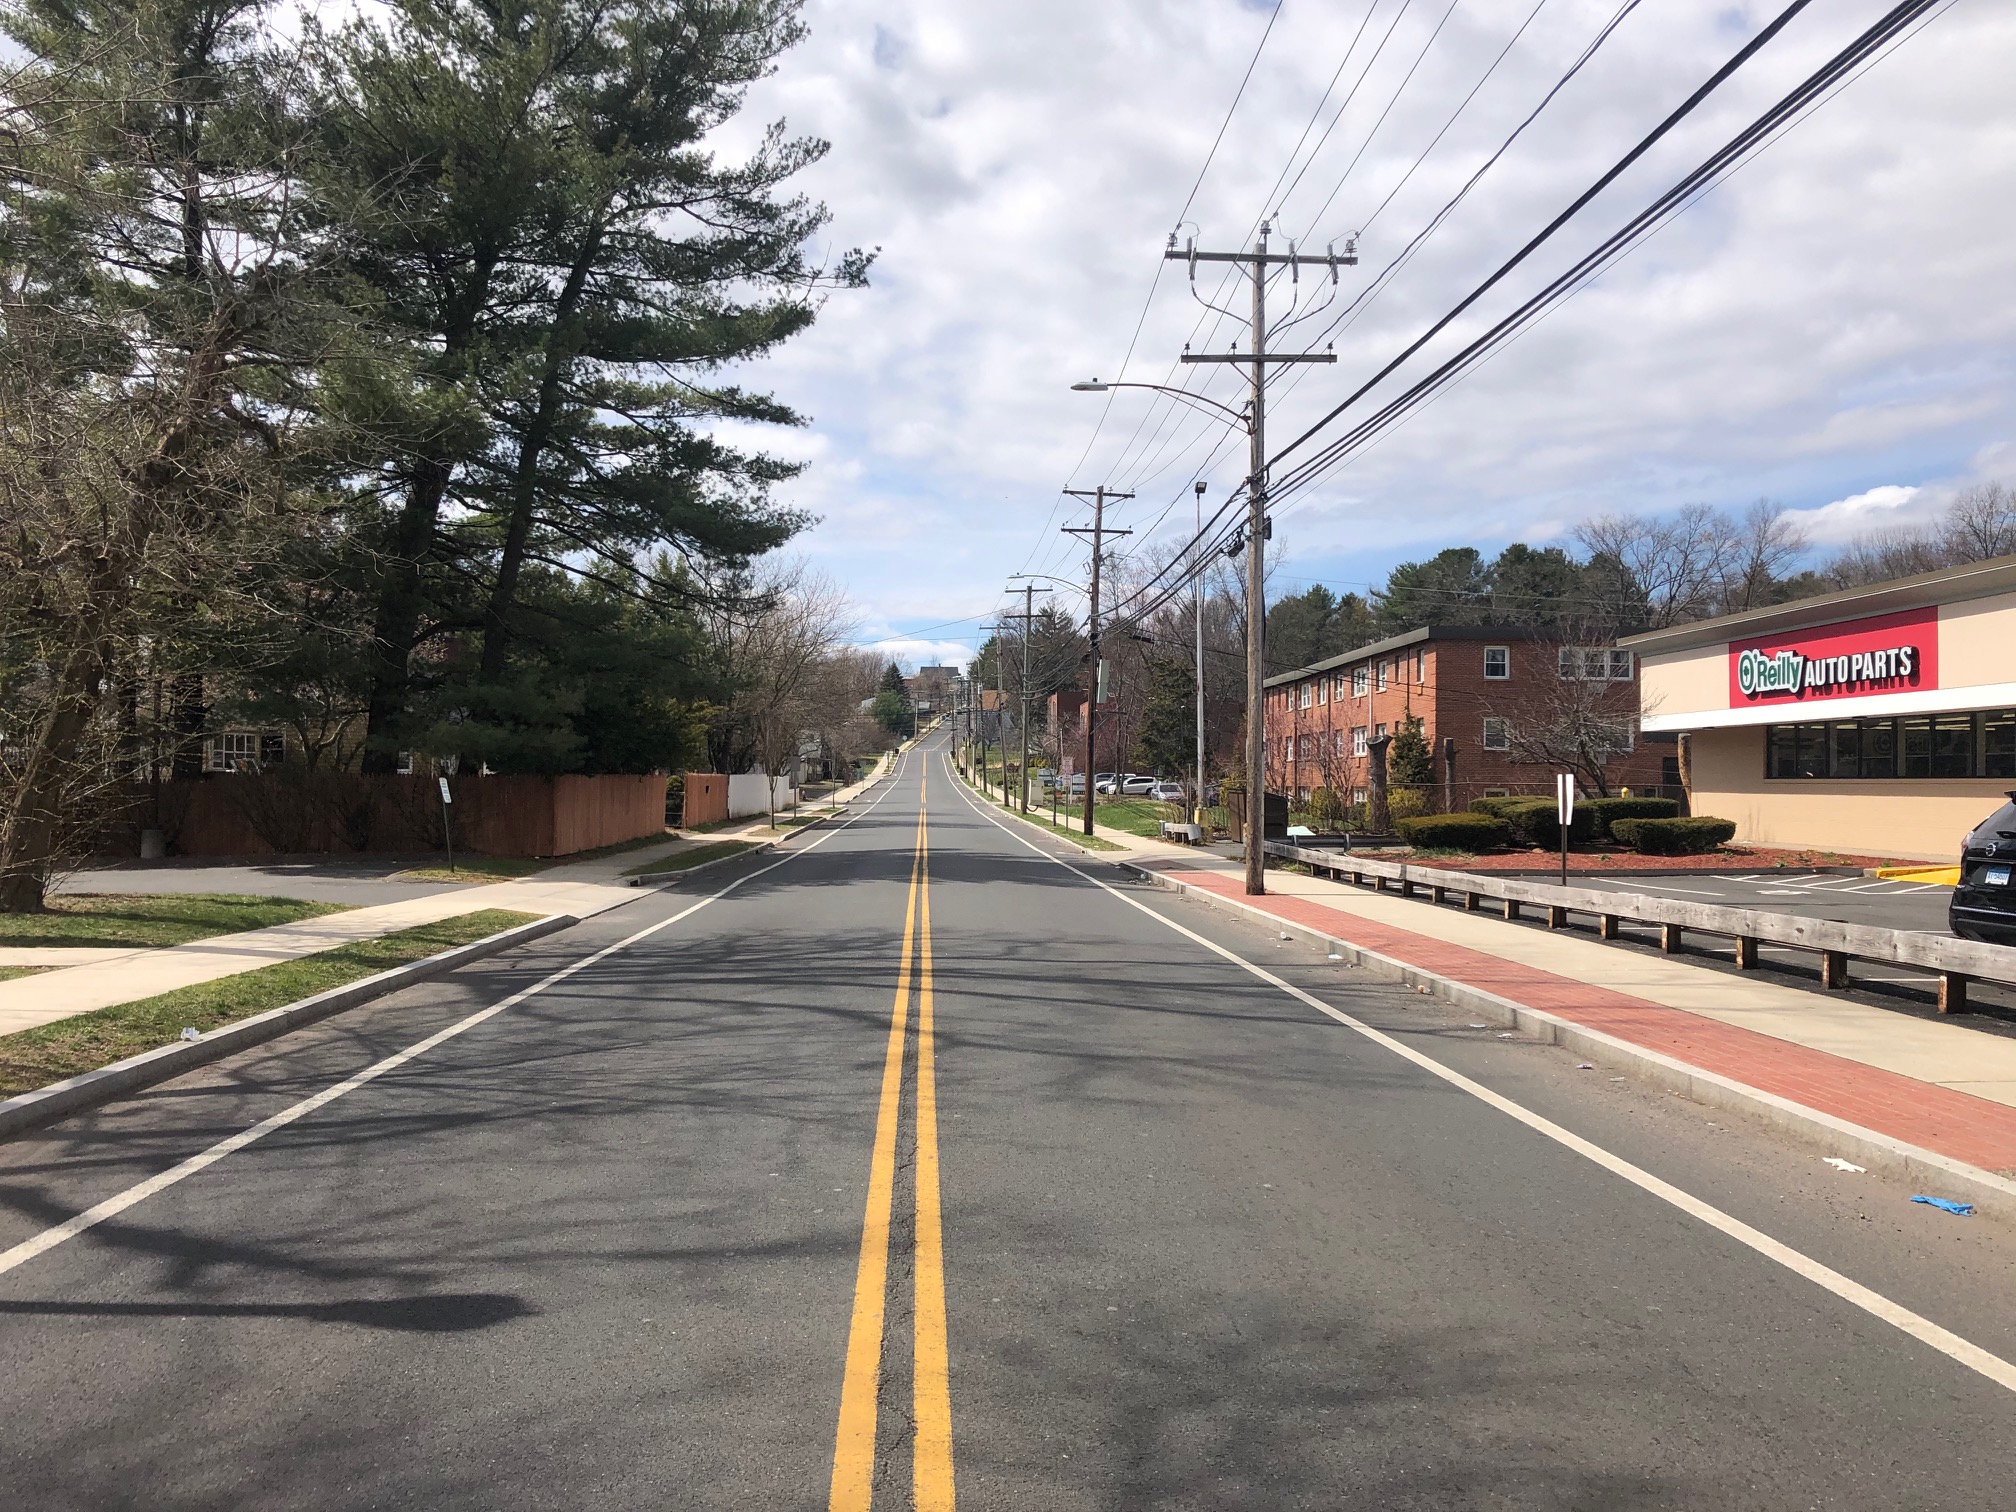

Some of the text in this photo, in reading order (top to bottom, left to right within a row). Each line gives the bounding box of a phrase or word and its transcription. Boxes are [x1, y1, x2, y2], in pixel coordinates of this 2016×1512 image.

[1739, 646, 1912, 692] O'Reilly AUTO PARTS
